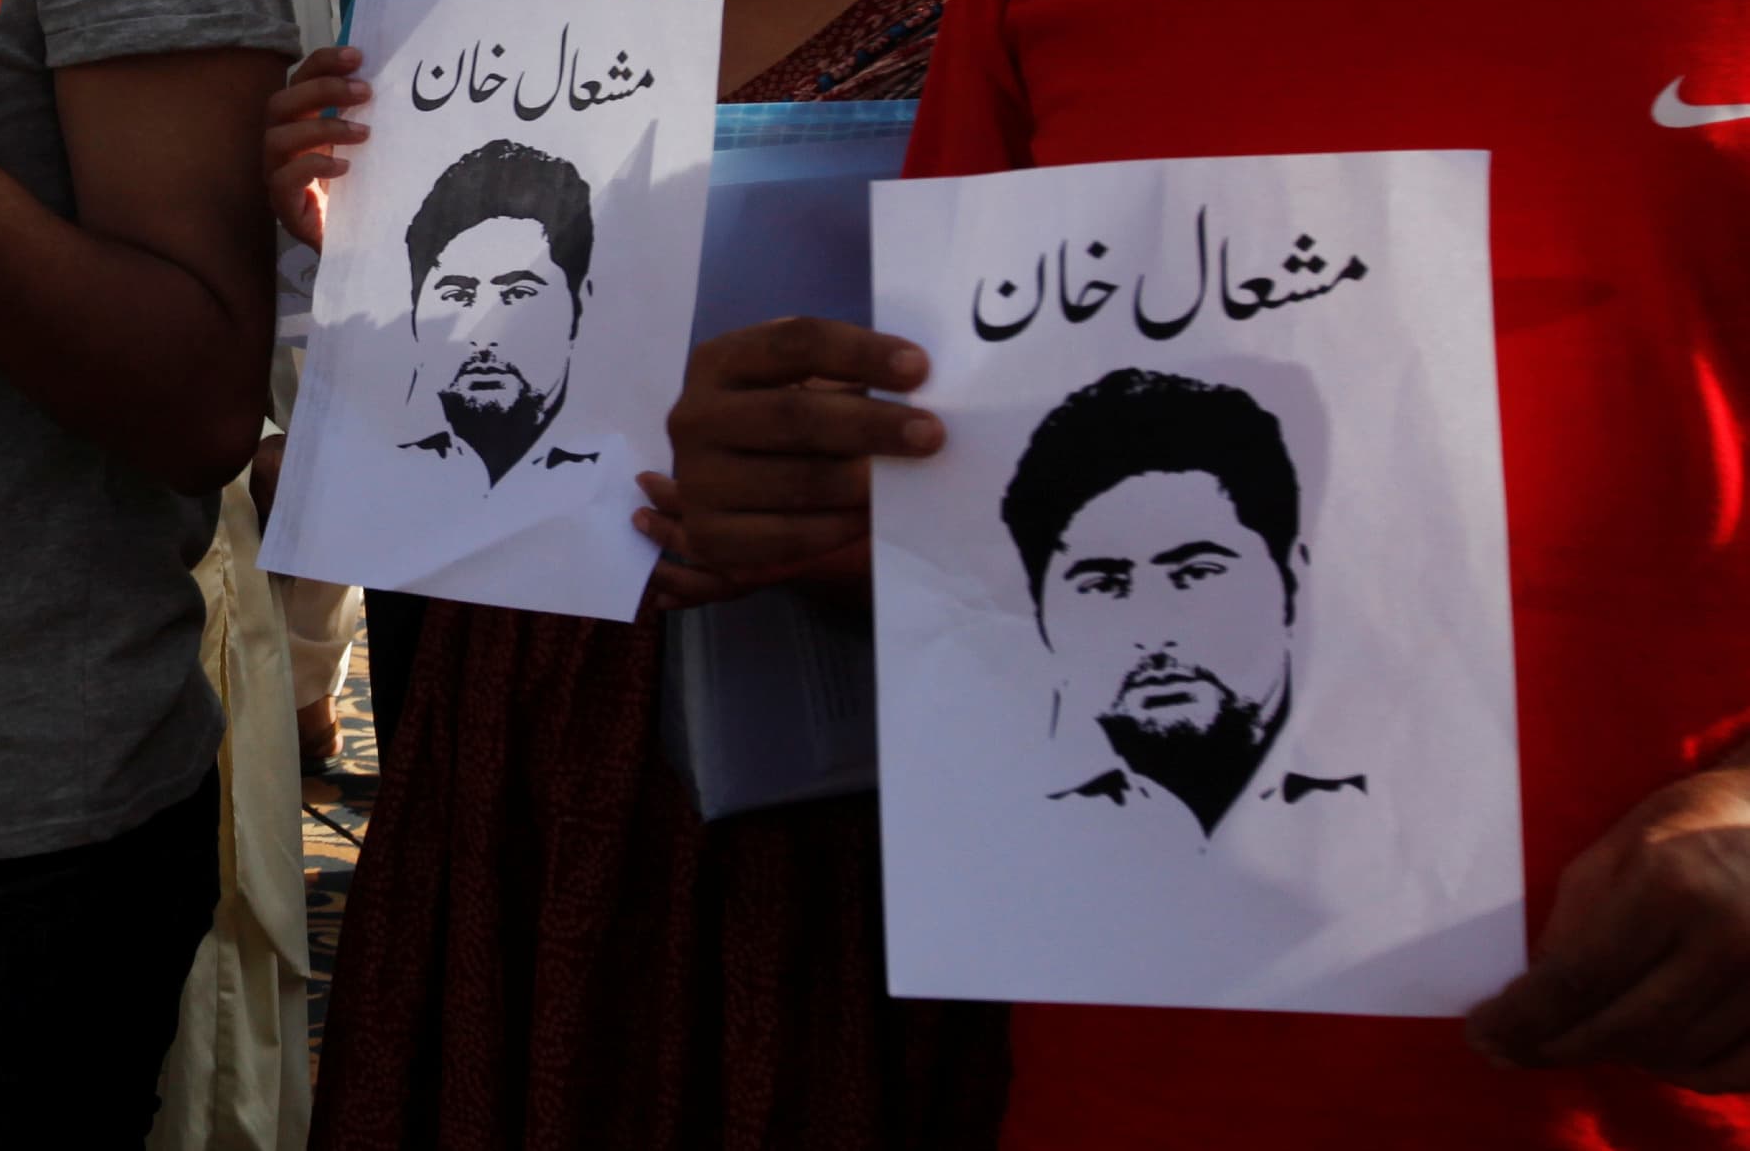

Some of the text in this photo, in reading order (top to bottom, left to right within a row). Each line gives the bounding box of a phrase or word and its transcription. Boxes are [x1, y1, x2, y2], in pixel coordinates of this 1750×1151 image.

[410, 20, 656, 122] مشعال خان
[970, 203, 1369, 343] مشعال خان
